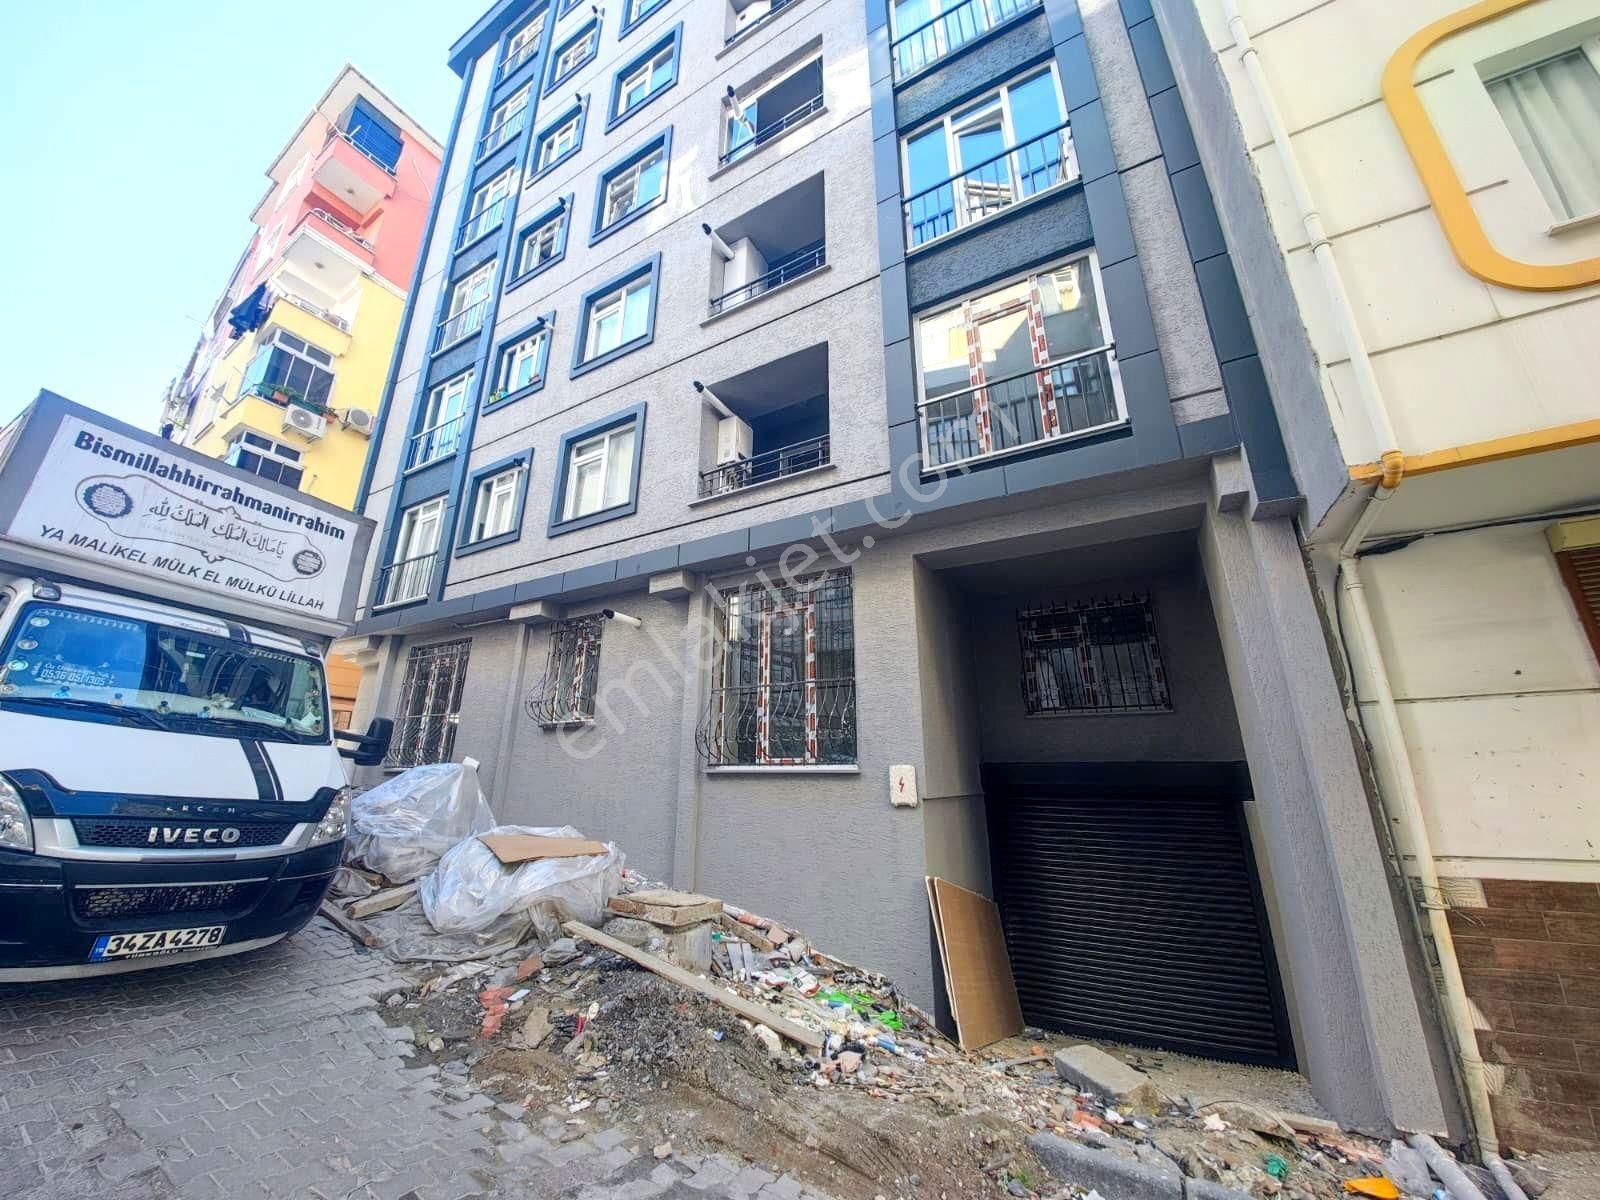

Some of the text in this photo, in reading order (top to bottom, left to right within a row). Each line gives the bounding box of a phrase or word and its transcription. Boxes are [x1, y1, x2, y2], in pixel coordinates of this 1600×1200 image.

[75, 430, 345, 540] Bismillahhirrahmanirrahim
[40, 524, 324, 610] YA MALİKEL MÜLK EL MÜLKÜ LİLLAH
[147, 826, 240, 843] IVECO
